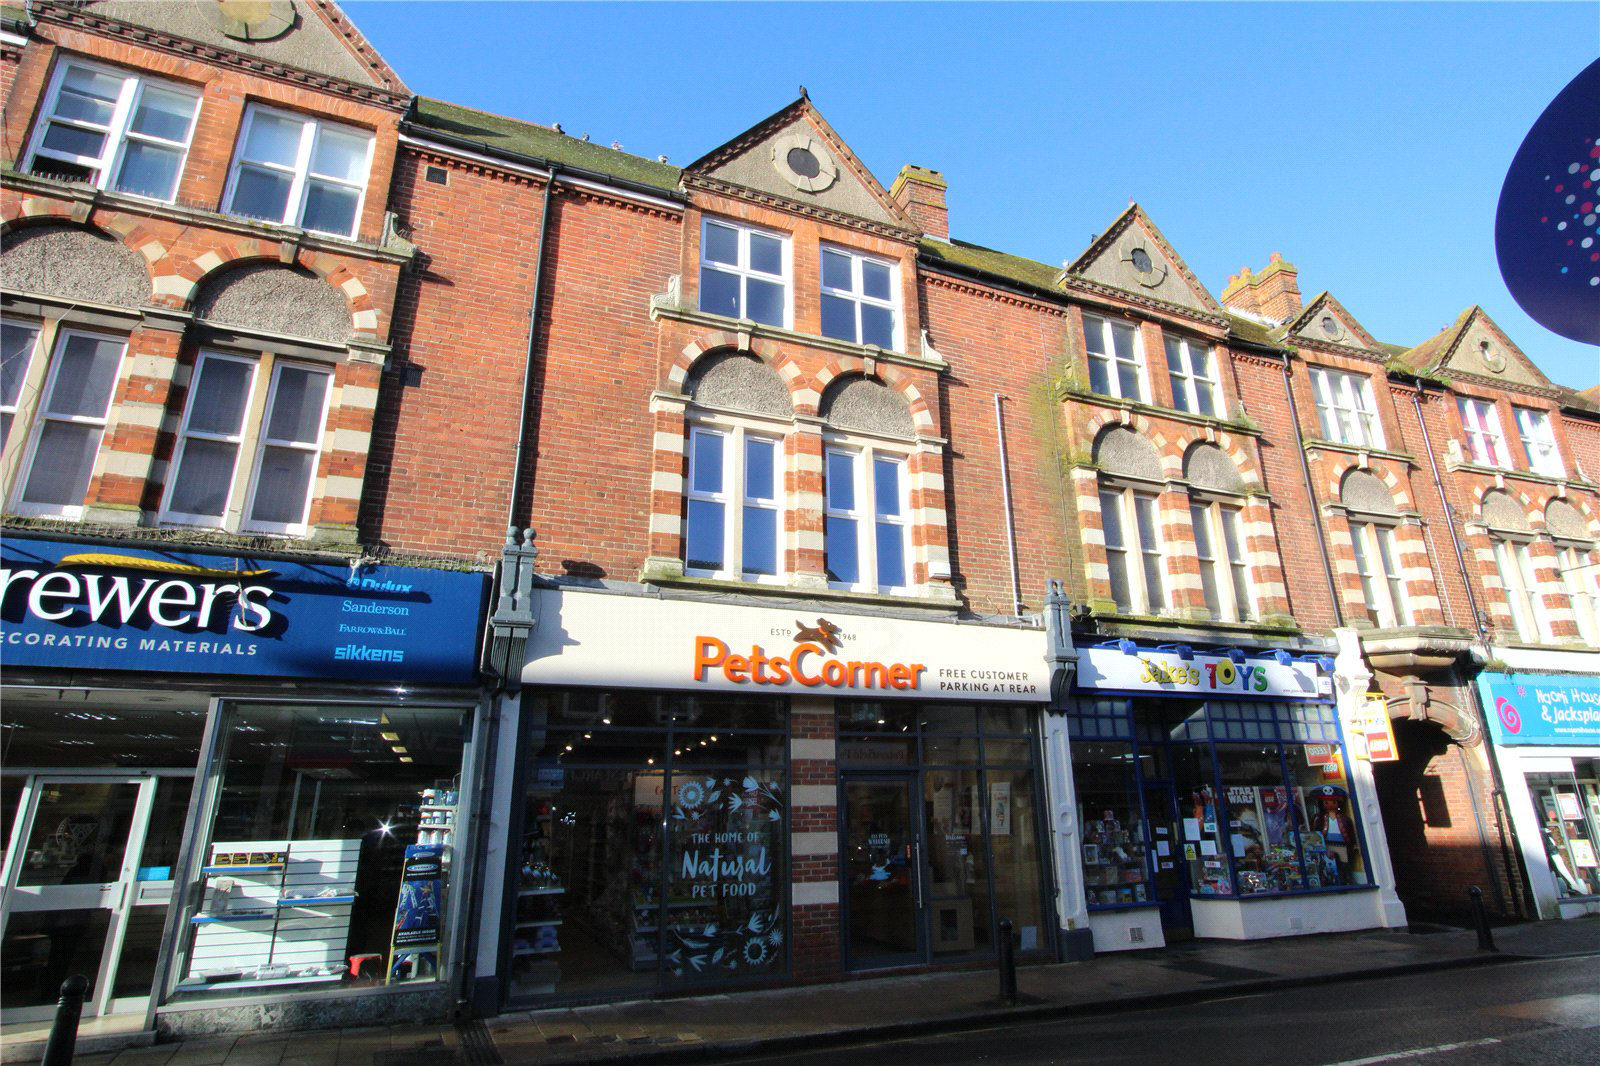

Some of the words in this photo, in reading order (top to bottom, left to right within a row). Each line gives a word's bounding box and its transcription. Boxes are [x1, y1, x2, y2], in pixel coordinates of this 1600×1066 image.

[0, 568, 274, 632] rewers
[342, 600, 409, 616] Sanderson
[838, 633, 857, 641] 1968
[139, 639, 258, 656] MATERIALS
[334, 645, 404, 662] sikkens
[939, 669, 966, 679] FREE
[970, 670, 1029, 681] CUSTOMER
[1141, 657, 1200, 687] Jake's
[1204, 658, 1268, 692] TOYS
[940, 682, 989, 692] PARKING
[993, 684, 1005, 693] AT
[1009, 684, 1037, 694] REAR
[1536, 688, 1569, 705] Naomi
[1570, 687, 1600, 706] Hous
[1541, 704, 1552, 722] &
[1228, 794, 1254, 804] WARS
[1229, 786, 1253, 796] STAR
[691, 833, 710, 844] THE
[714, 832, 743, 843] HOME
[747, 831, 760, 843] OF
[681, 847, 772, 882] Natural
[692, 884, 718, 899] PET
[722, 882, 757, 897] FOOD
